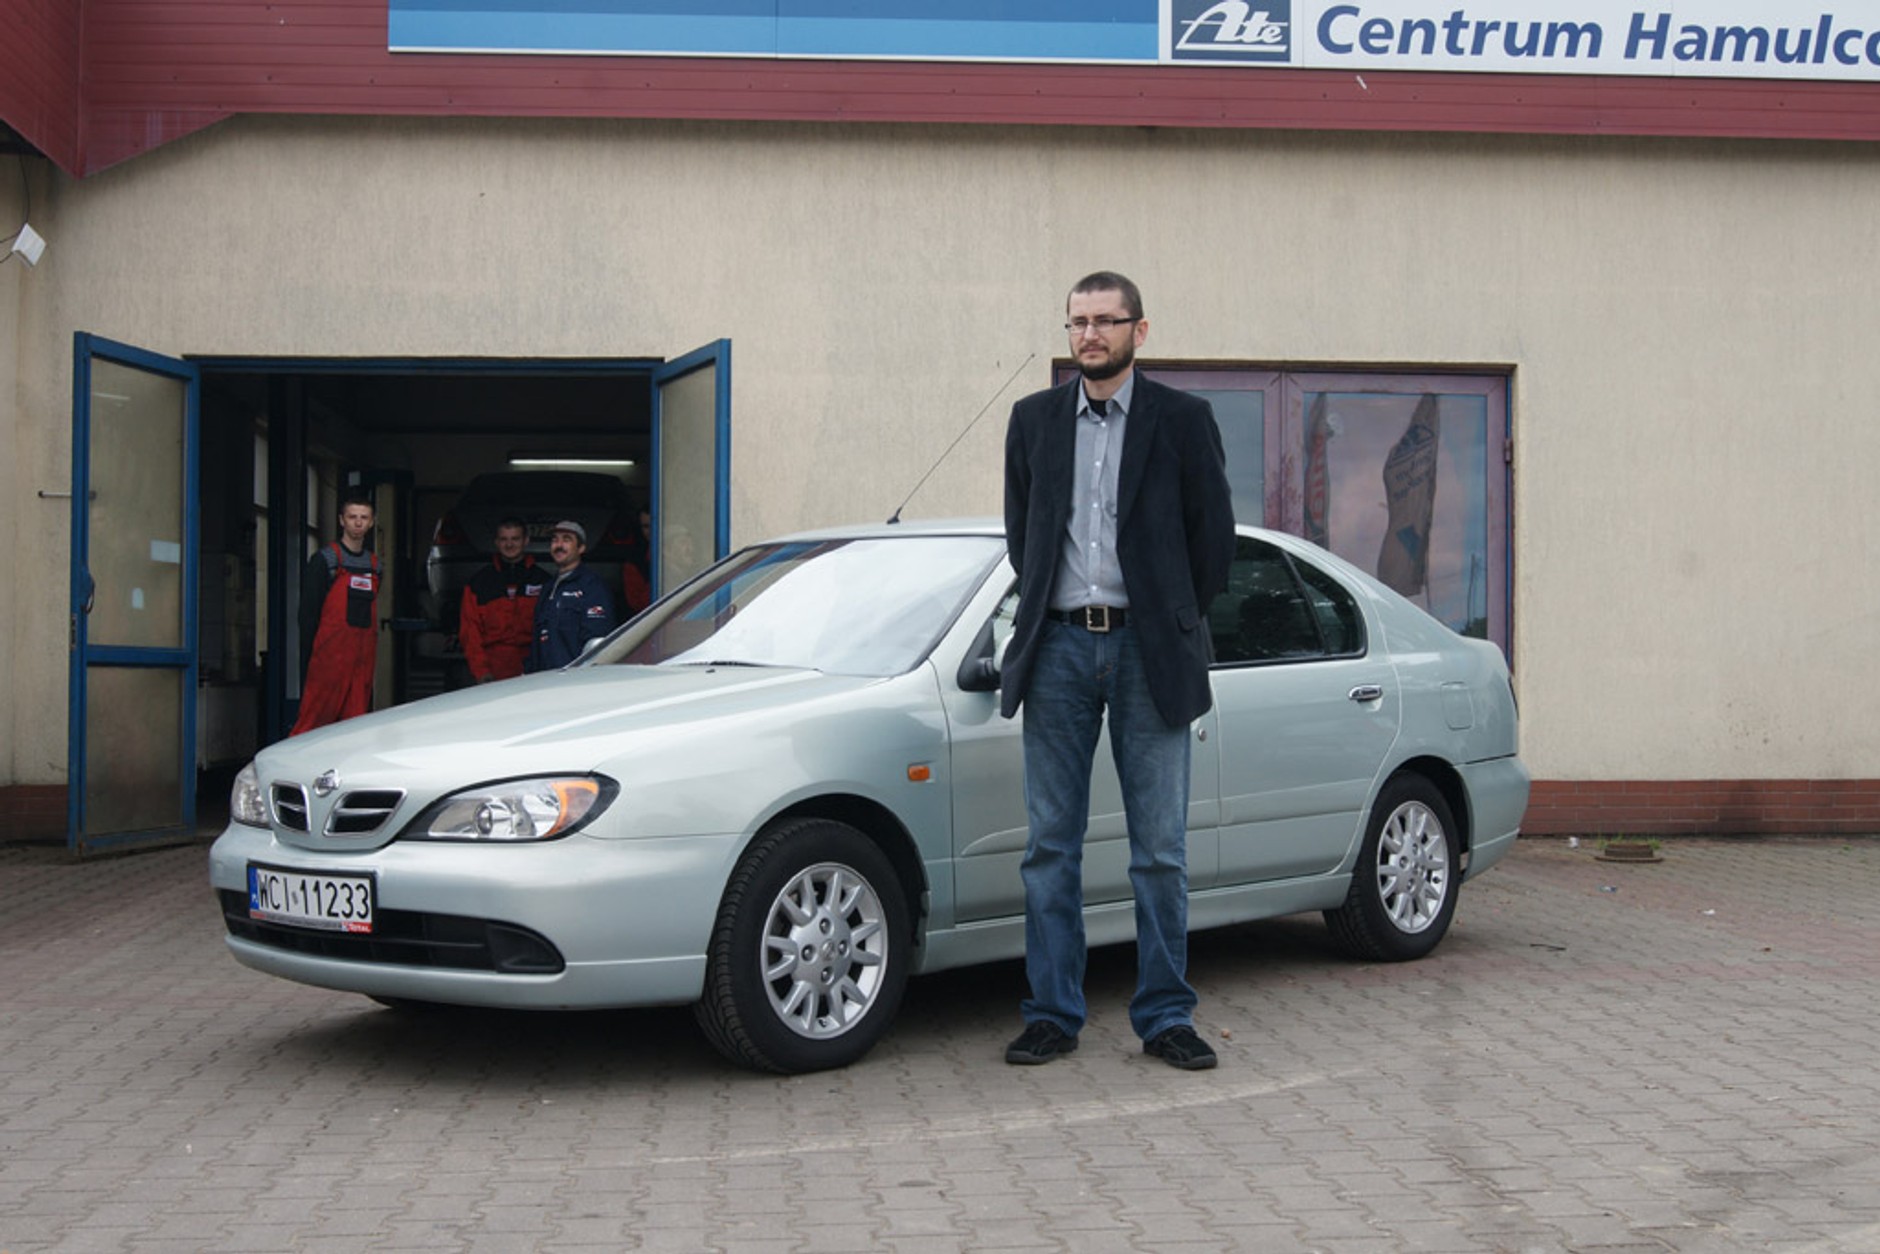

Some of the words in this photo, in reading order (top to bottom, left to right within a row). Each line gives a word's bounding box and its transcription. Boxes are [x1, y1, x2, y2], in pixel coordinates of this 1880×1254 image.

[1316, 4, 1604, 59] Centrum
[257, 873, 290, 912] WCI
[299, 878, 370, 919] 11233
